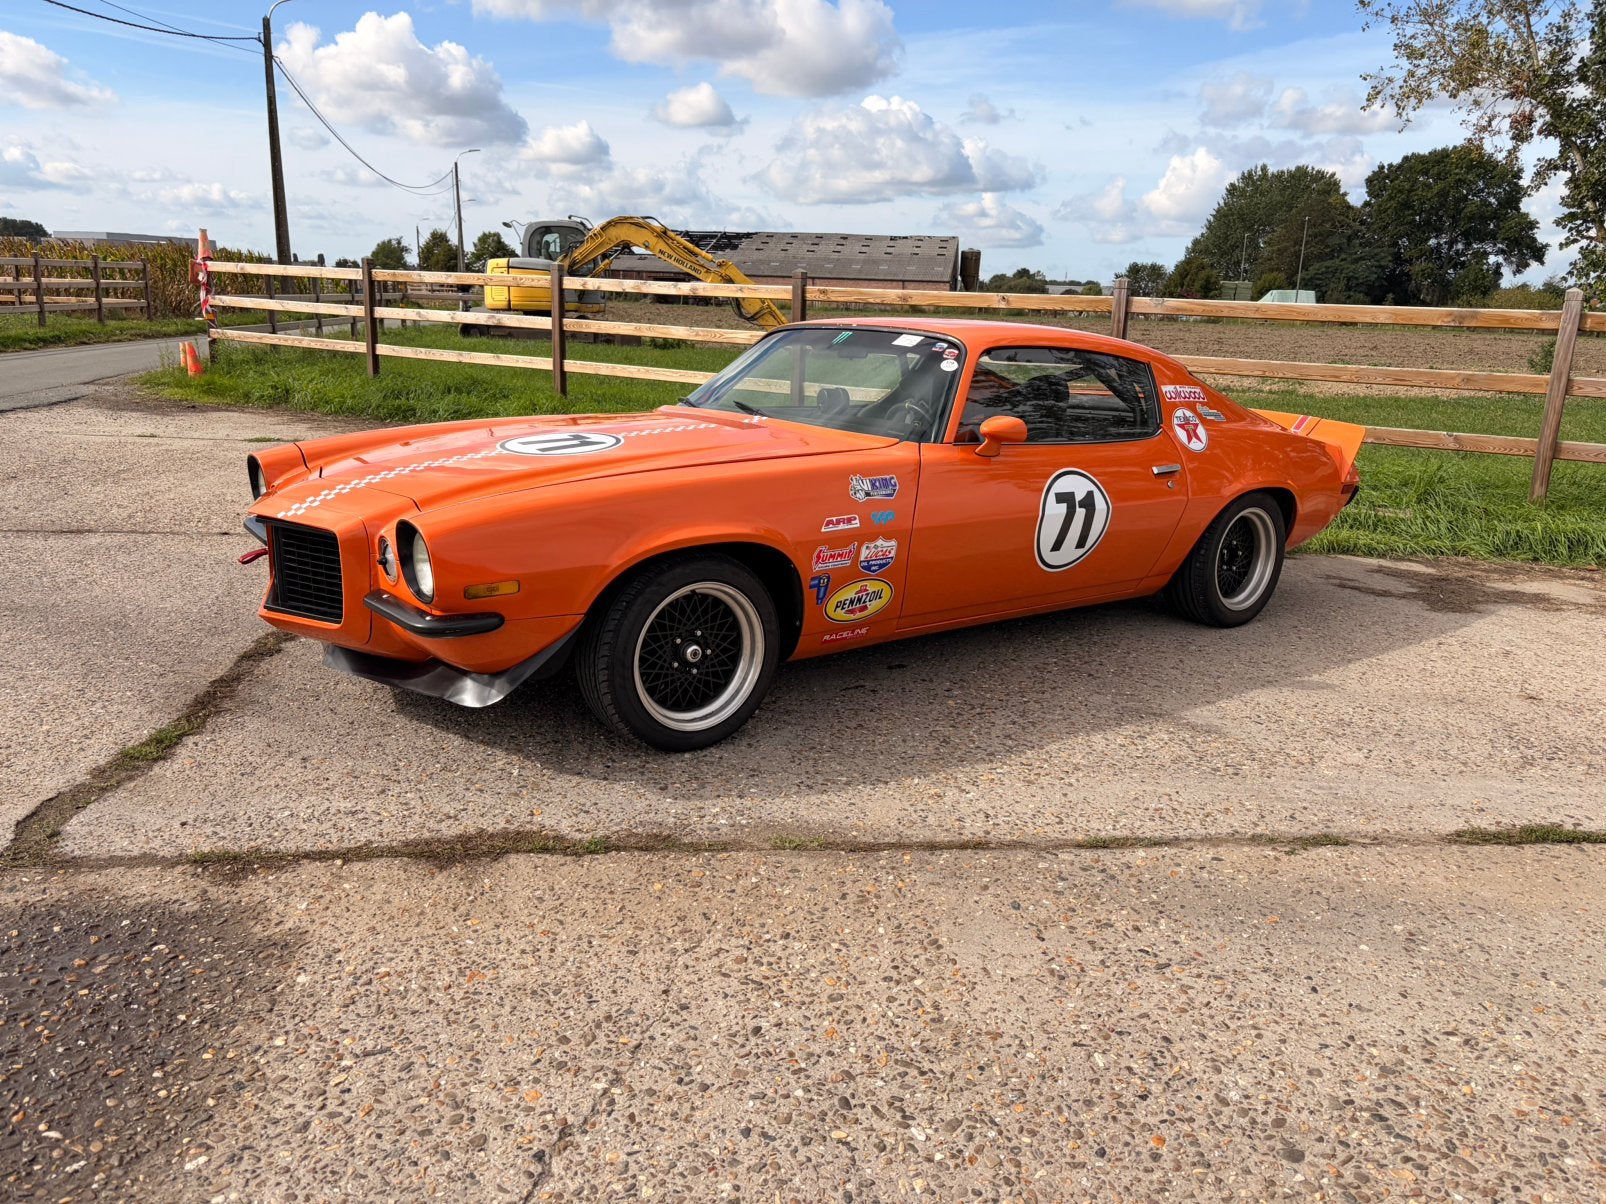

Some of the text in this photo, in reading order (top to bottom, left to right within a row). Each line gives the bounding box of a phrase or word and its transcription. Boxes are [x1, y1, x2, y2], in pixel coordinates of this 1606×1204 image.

[659, 248, 703, 276] NEW HOLLAND
[517, 433, 608, 453] 71
[859, 476, 897, 491] VIKING
[825, 515, 858, 528] ARP
[1049, 490, 1096, 553] 71
[815, 547, 855, 567] SUMMIT
[864, 547, 894, 560] LUCAS
[869, 557, 892, 566] PRODUCTS
[833, 588, 884, 613] PENNZOIL
[822, 627, 870, 641] RACELINE
